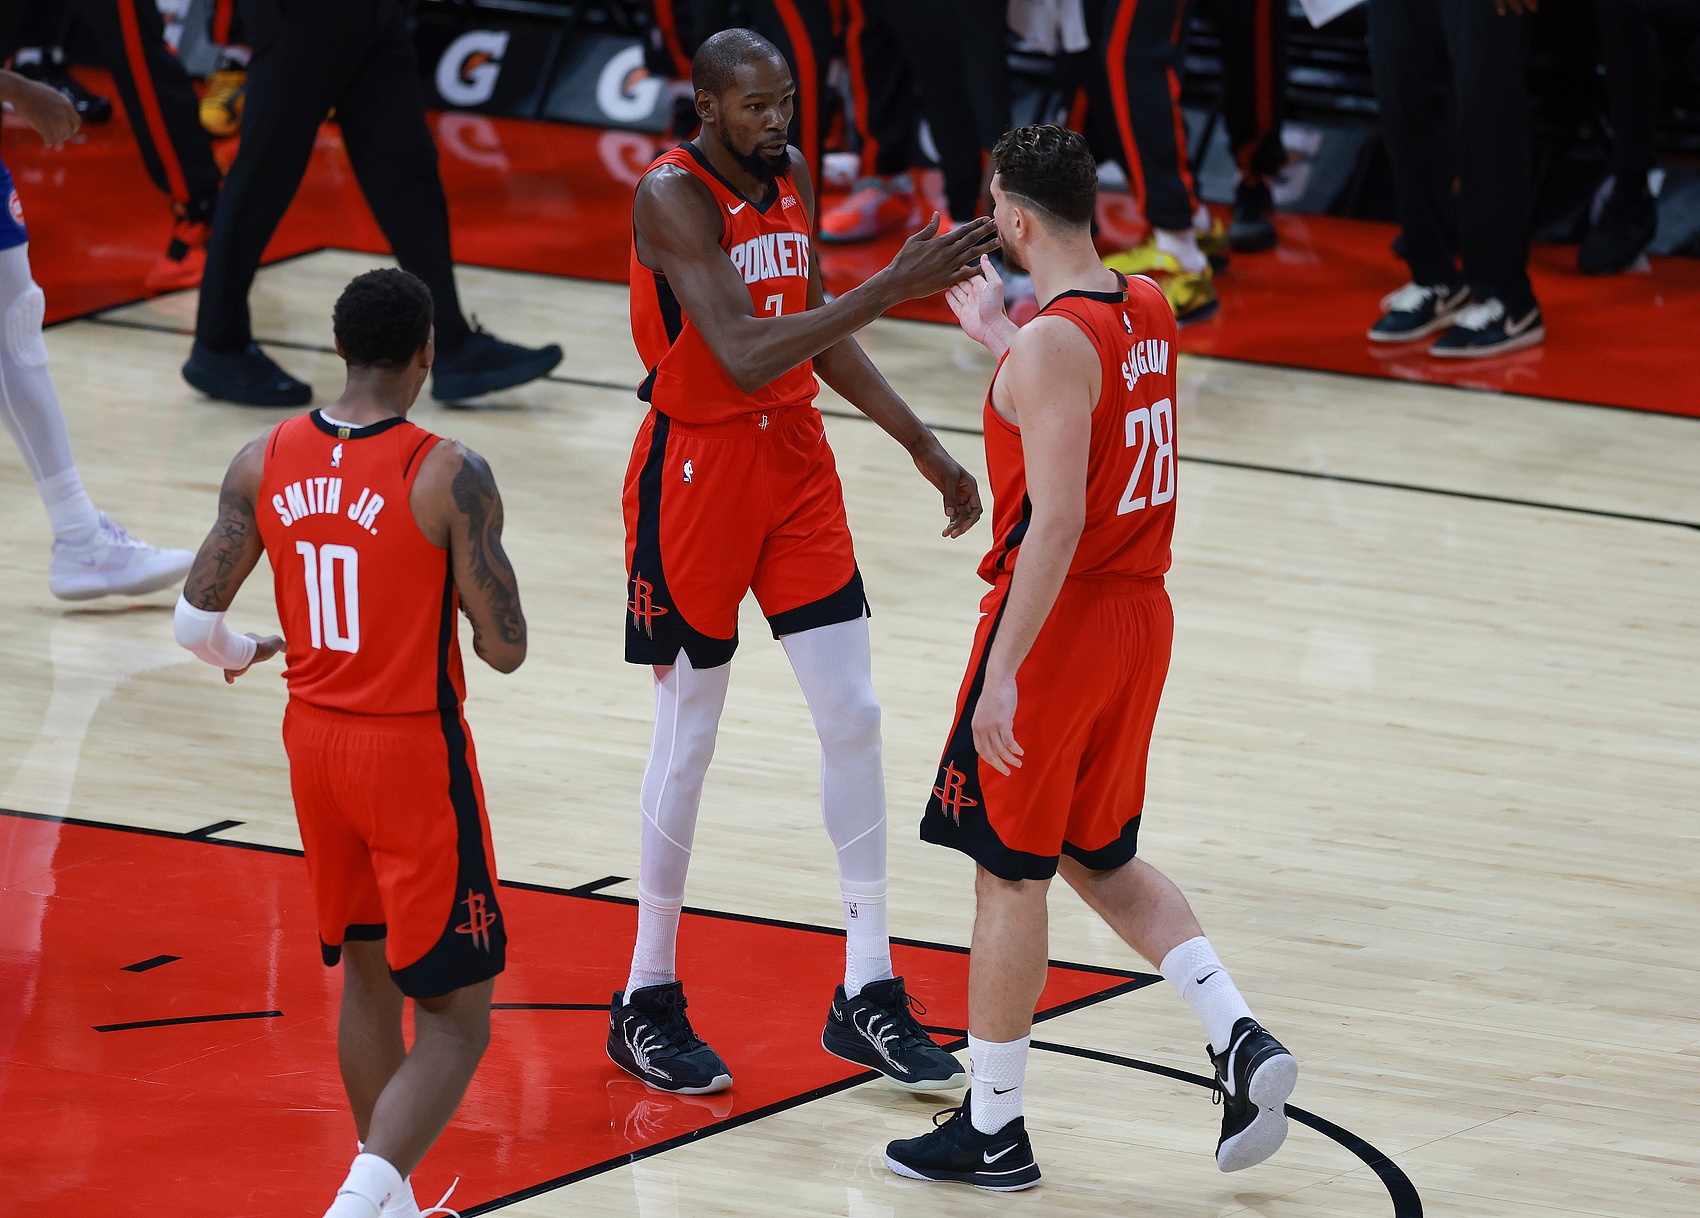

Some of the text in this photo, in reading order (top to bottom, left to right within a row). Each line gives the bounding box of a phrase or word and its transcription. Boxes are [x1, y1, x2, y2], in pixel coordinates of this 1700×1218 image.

[434, 29, 511, 107] G
[596, 44, 665, 122] G
[1117, 397, 1175, 516] 28
[272, 477, 385, 536] SMITH JR.
[295, 540, 360, 654] 10
